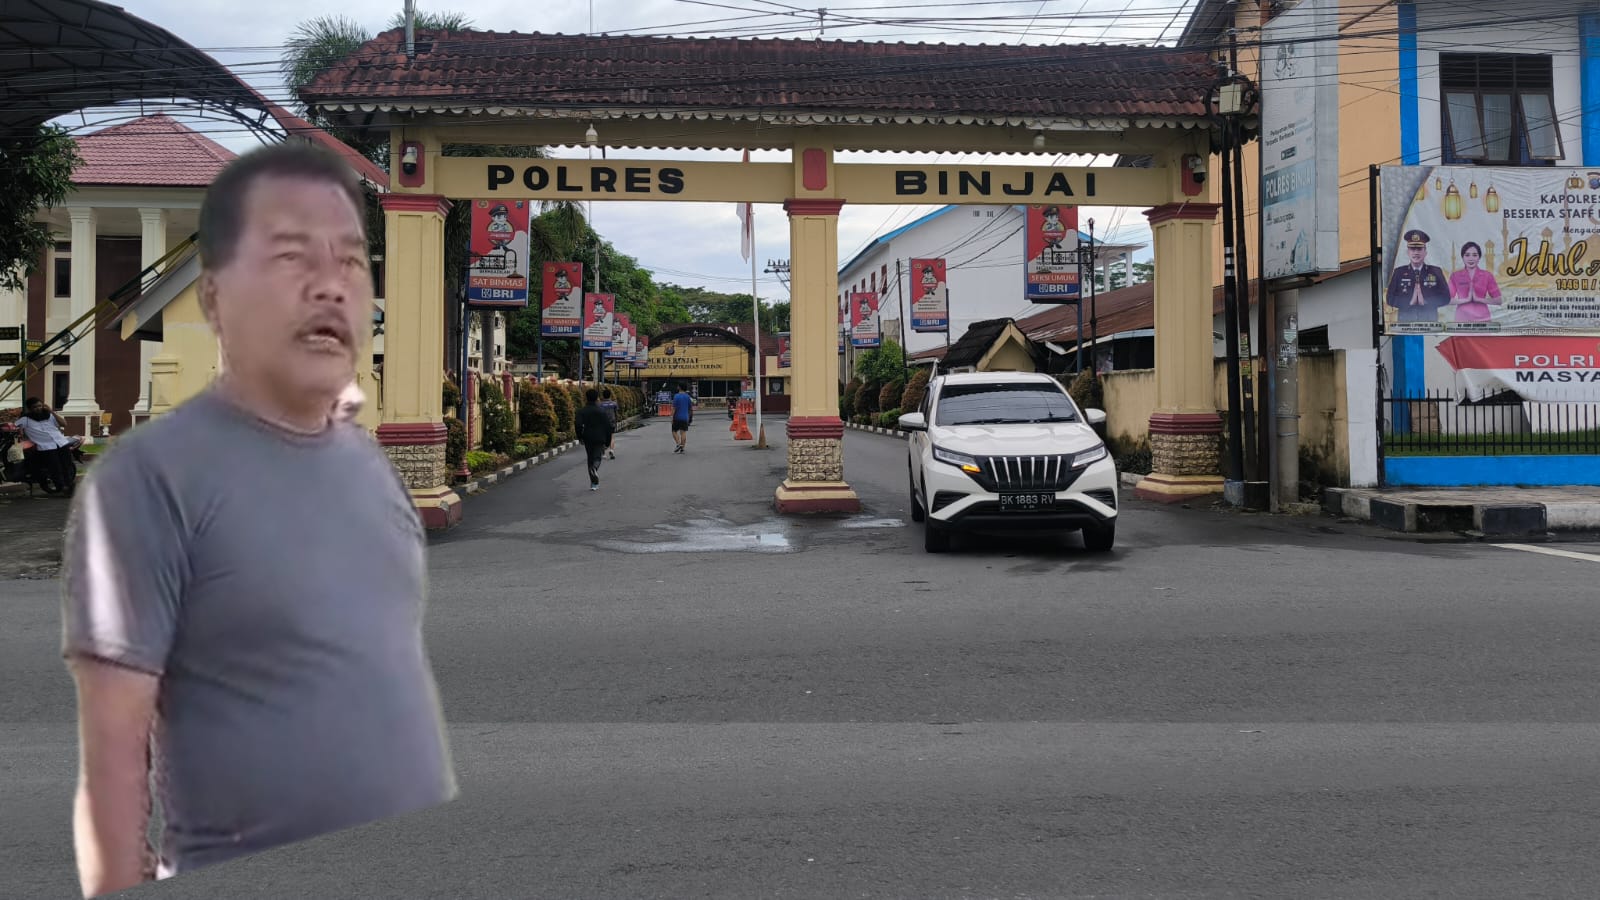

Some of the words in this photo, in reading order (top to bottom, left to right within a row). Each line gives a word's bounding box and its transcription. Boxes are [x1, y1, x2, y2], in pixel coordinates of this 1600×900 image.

[487, 164, 685, 194] POLRES
[895, 170, 1096, 197] BINJAI
[1265, 176, 1290, 199] POLRES
[1540, 194, 1600, 204] KAPOLRE
[1503, 209, 1555, 219] BESERTA
[1558, 209, 1594, 219] STAFF
[1506, 237, 1588, 277] Idul
[472, 278, 488, 286] SAT
[489, 278, 523, 287] BINMAS
[1555, 278, 1580, 291] 1446
[1581, 278, 1589, 291] H
[492, 289, 514, 299] BRI
[1048, 284, 1068, 293] BRI
[1514, 354, 1594, 367] POLRI
[1001, 495, 1014, 505] BK
[1041, 494, 1055, 504] RV
